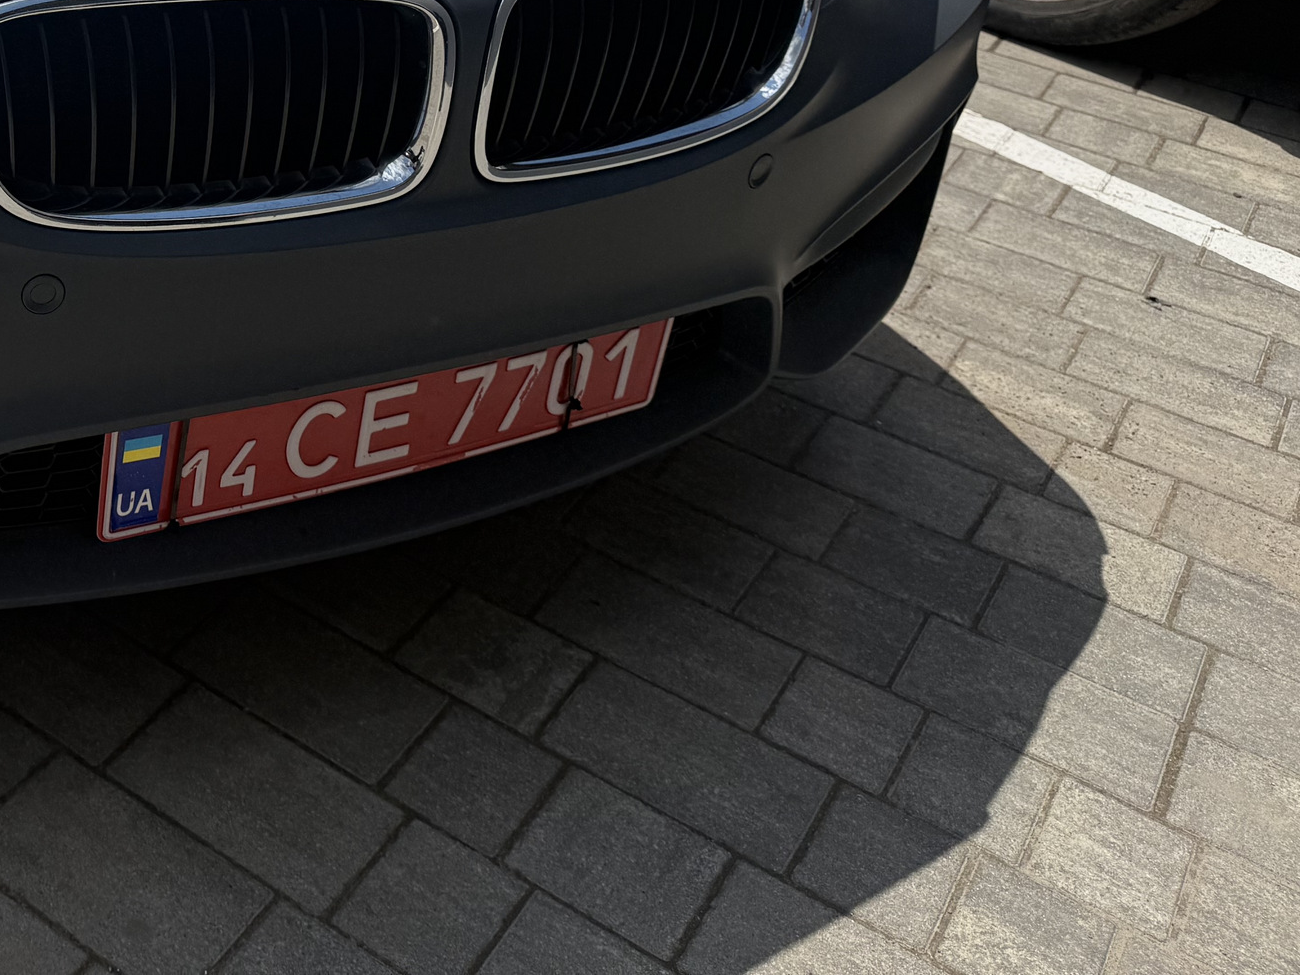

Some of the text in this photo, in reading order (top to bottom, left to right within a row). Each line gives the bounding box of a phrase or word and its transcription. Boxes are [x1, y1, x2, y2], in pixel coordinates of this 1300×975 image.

[181, 328, 640, 507] 14 CE 7701
[116, 488, 154, 517] UA
